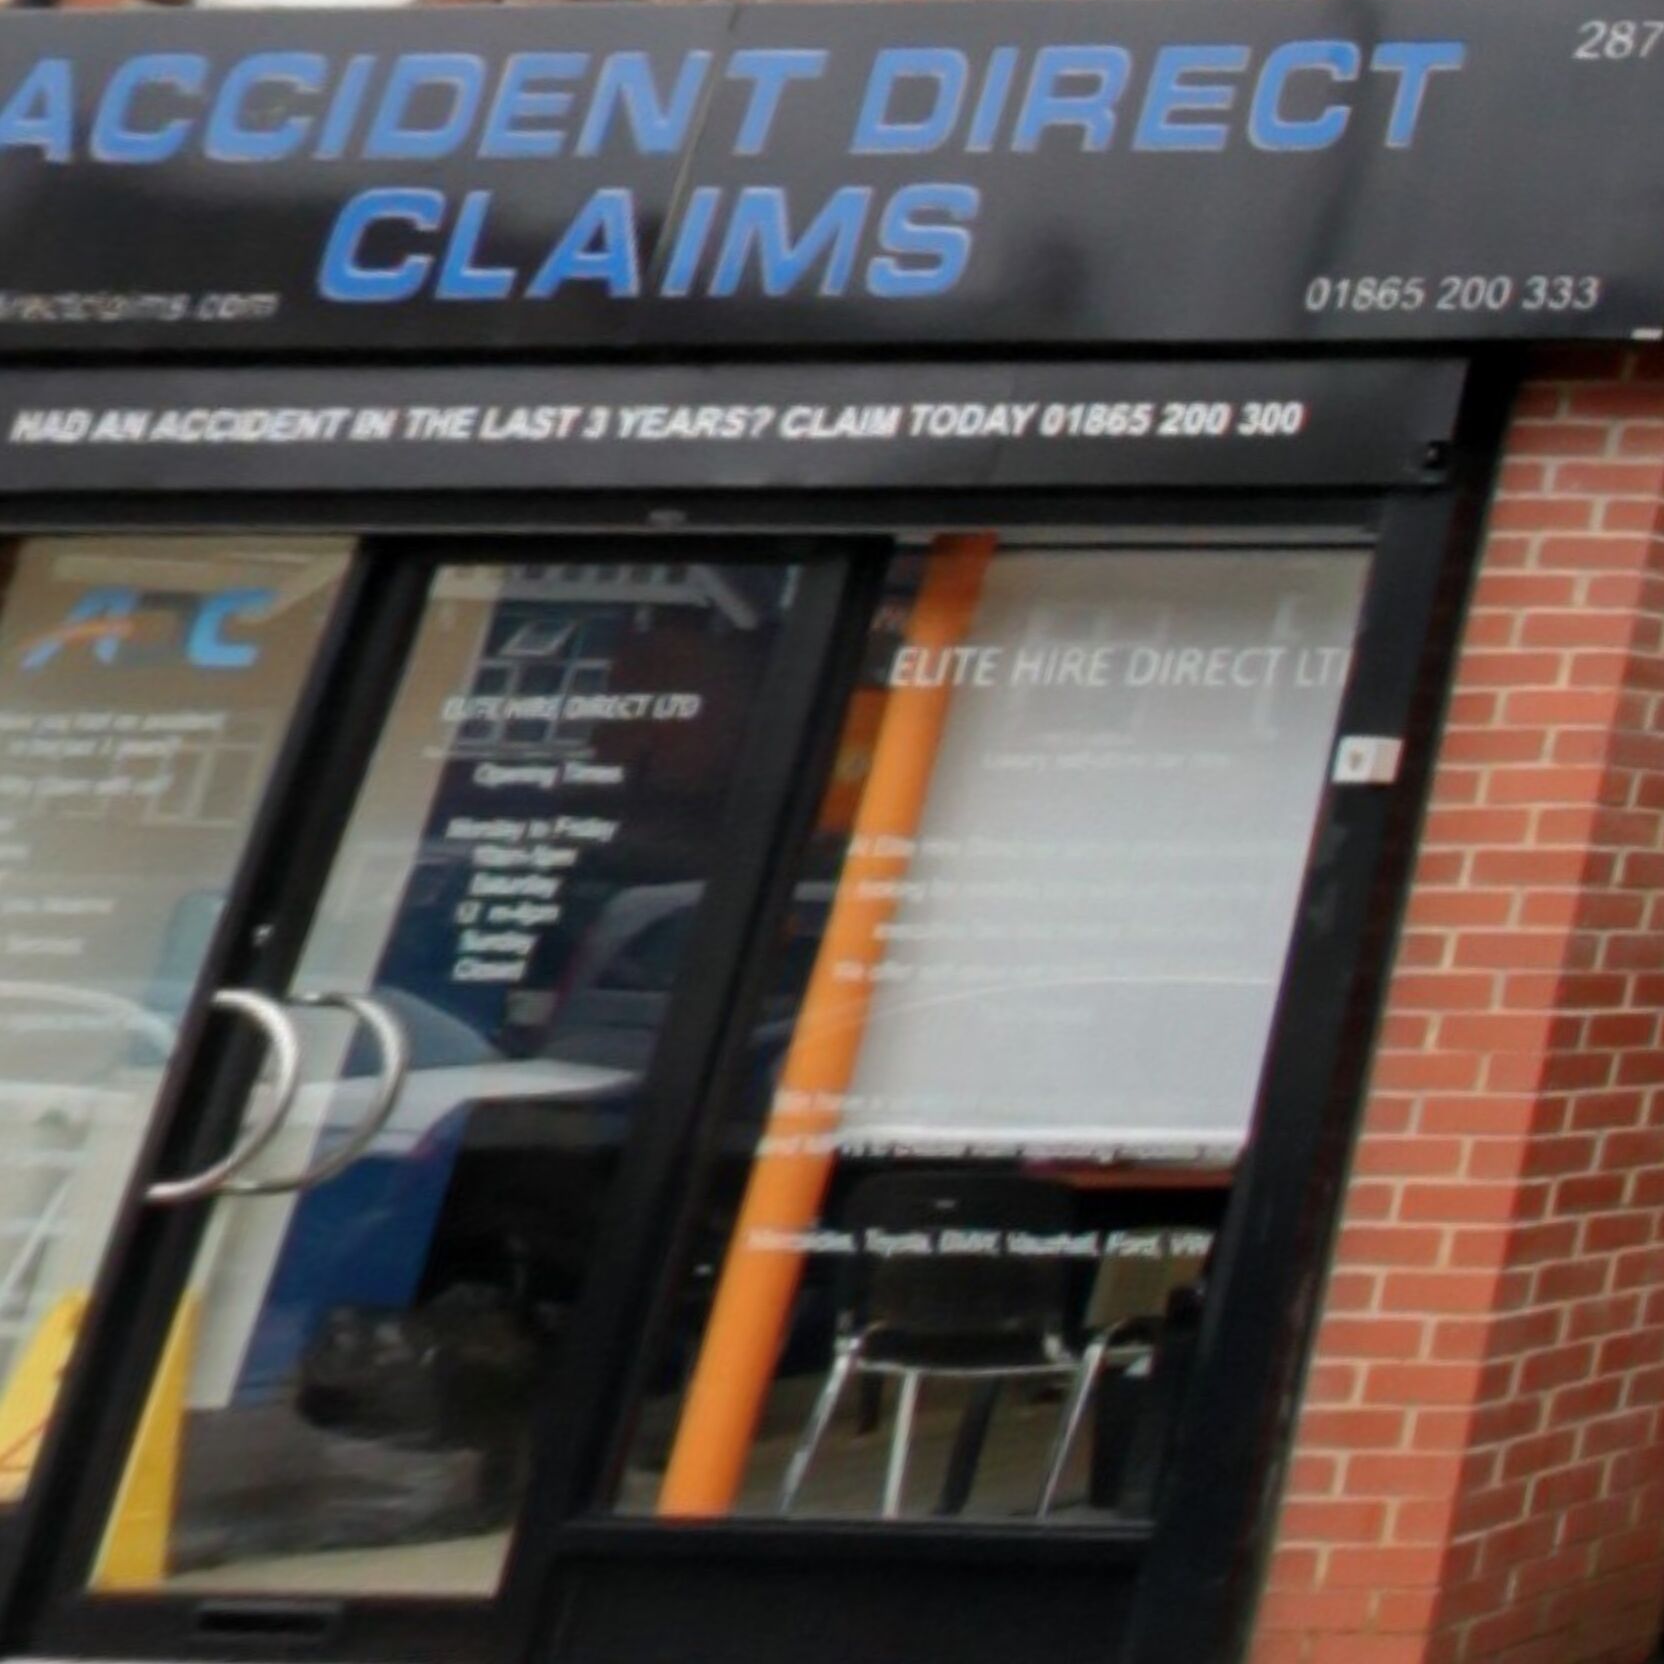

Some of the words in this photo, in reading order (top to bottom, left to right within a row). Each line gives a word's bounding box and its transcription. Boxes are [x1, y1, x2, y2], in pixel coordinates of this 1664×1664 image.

[0, 51, 822, 164] ACCIDENT
[853, 38, 1465, 151] DIRECT
[317, 183, 979, 303] CLAIMS
[1304, 276, 1424, 312] 01865
[1436, 276, 1517, 311] 200
[1522, 276, 1600, 310] 333
[10, 407, 93, 443] HAD
[89, 408, 149, 443] AN
[150, 407, 350, 443] ACCIDENT
[347, 407, 397, 440] IN
[405, 405, 478, 440] THE
[480, 405, 583, 440] LAST
[583, 406, 608, 439] 3
[617, 404, 771, 439] YEARS?
[780, 403, 898, 439] CLAIM
[908, 403, 1036, 438] TODAY
[1040, 401, 1151, 437] 01865
[1158, 401, 1233, 436] 200
[1238, 401, 1305, 436] 300
[888, 645, 1001, 687] ELITE
[1008, 645, 1108, 687] HIRE
[1124, 645, 1288, 687] DIRECT
